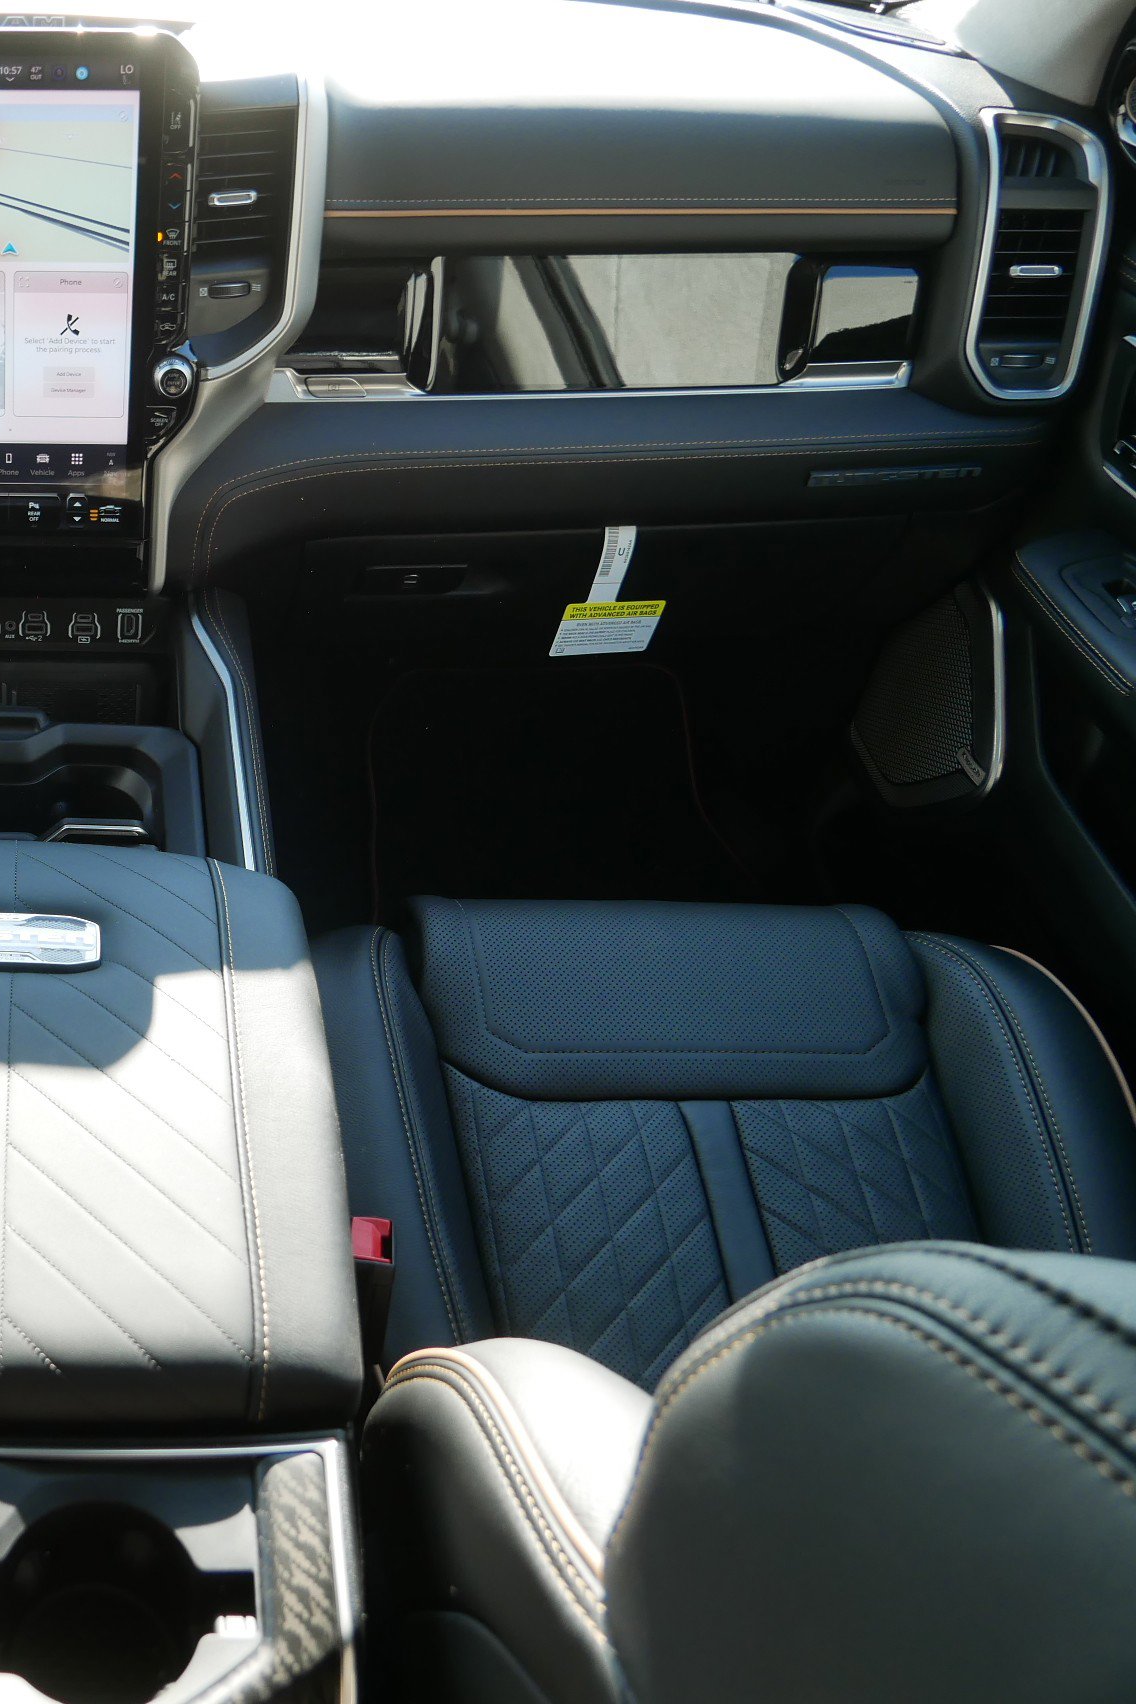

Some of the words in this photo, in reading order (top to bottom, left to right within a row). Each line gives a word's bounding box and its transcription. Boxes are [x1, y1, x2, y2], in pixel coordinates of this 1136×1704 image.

[0, 66, 22, 75] 10:57
[120, 65, 134, 74] LO
[59, 278, 82, 286] Phone
[162, 293, 176, 301] A/C
[24, 337, 45, 345] Select
[48, 346, 73, 354] pairing
[67, 469, 85, 477] Apps
